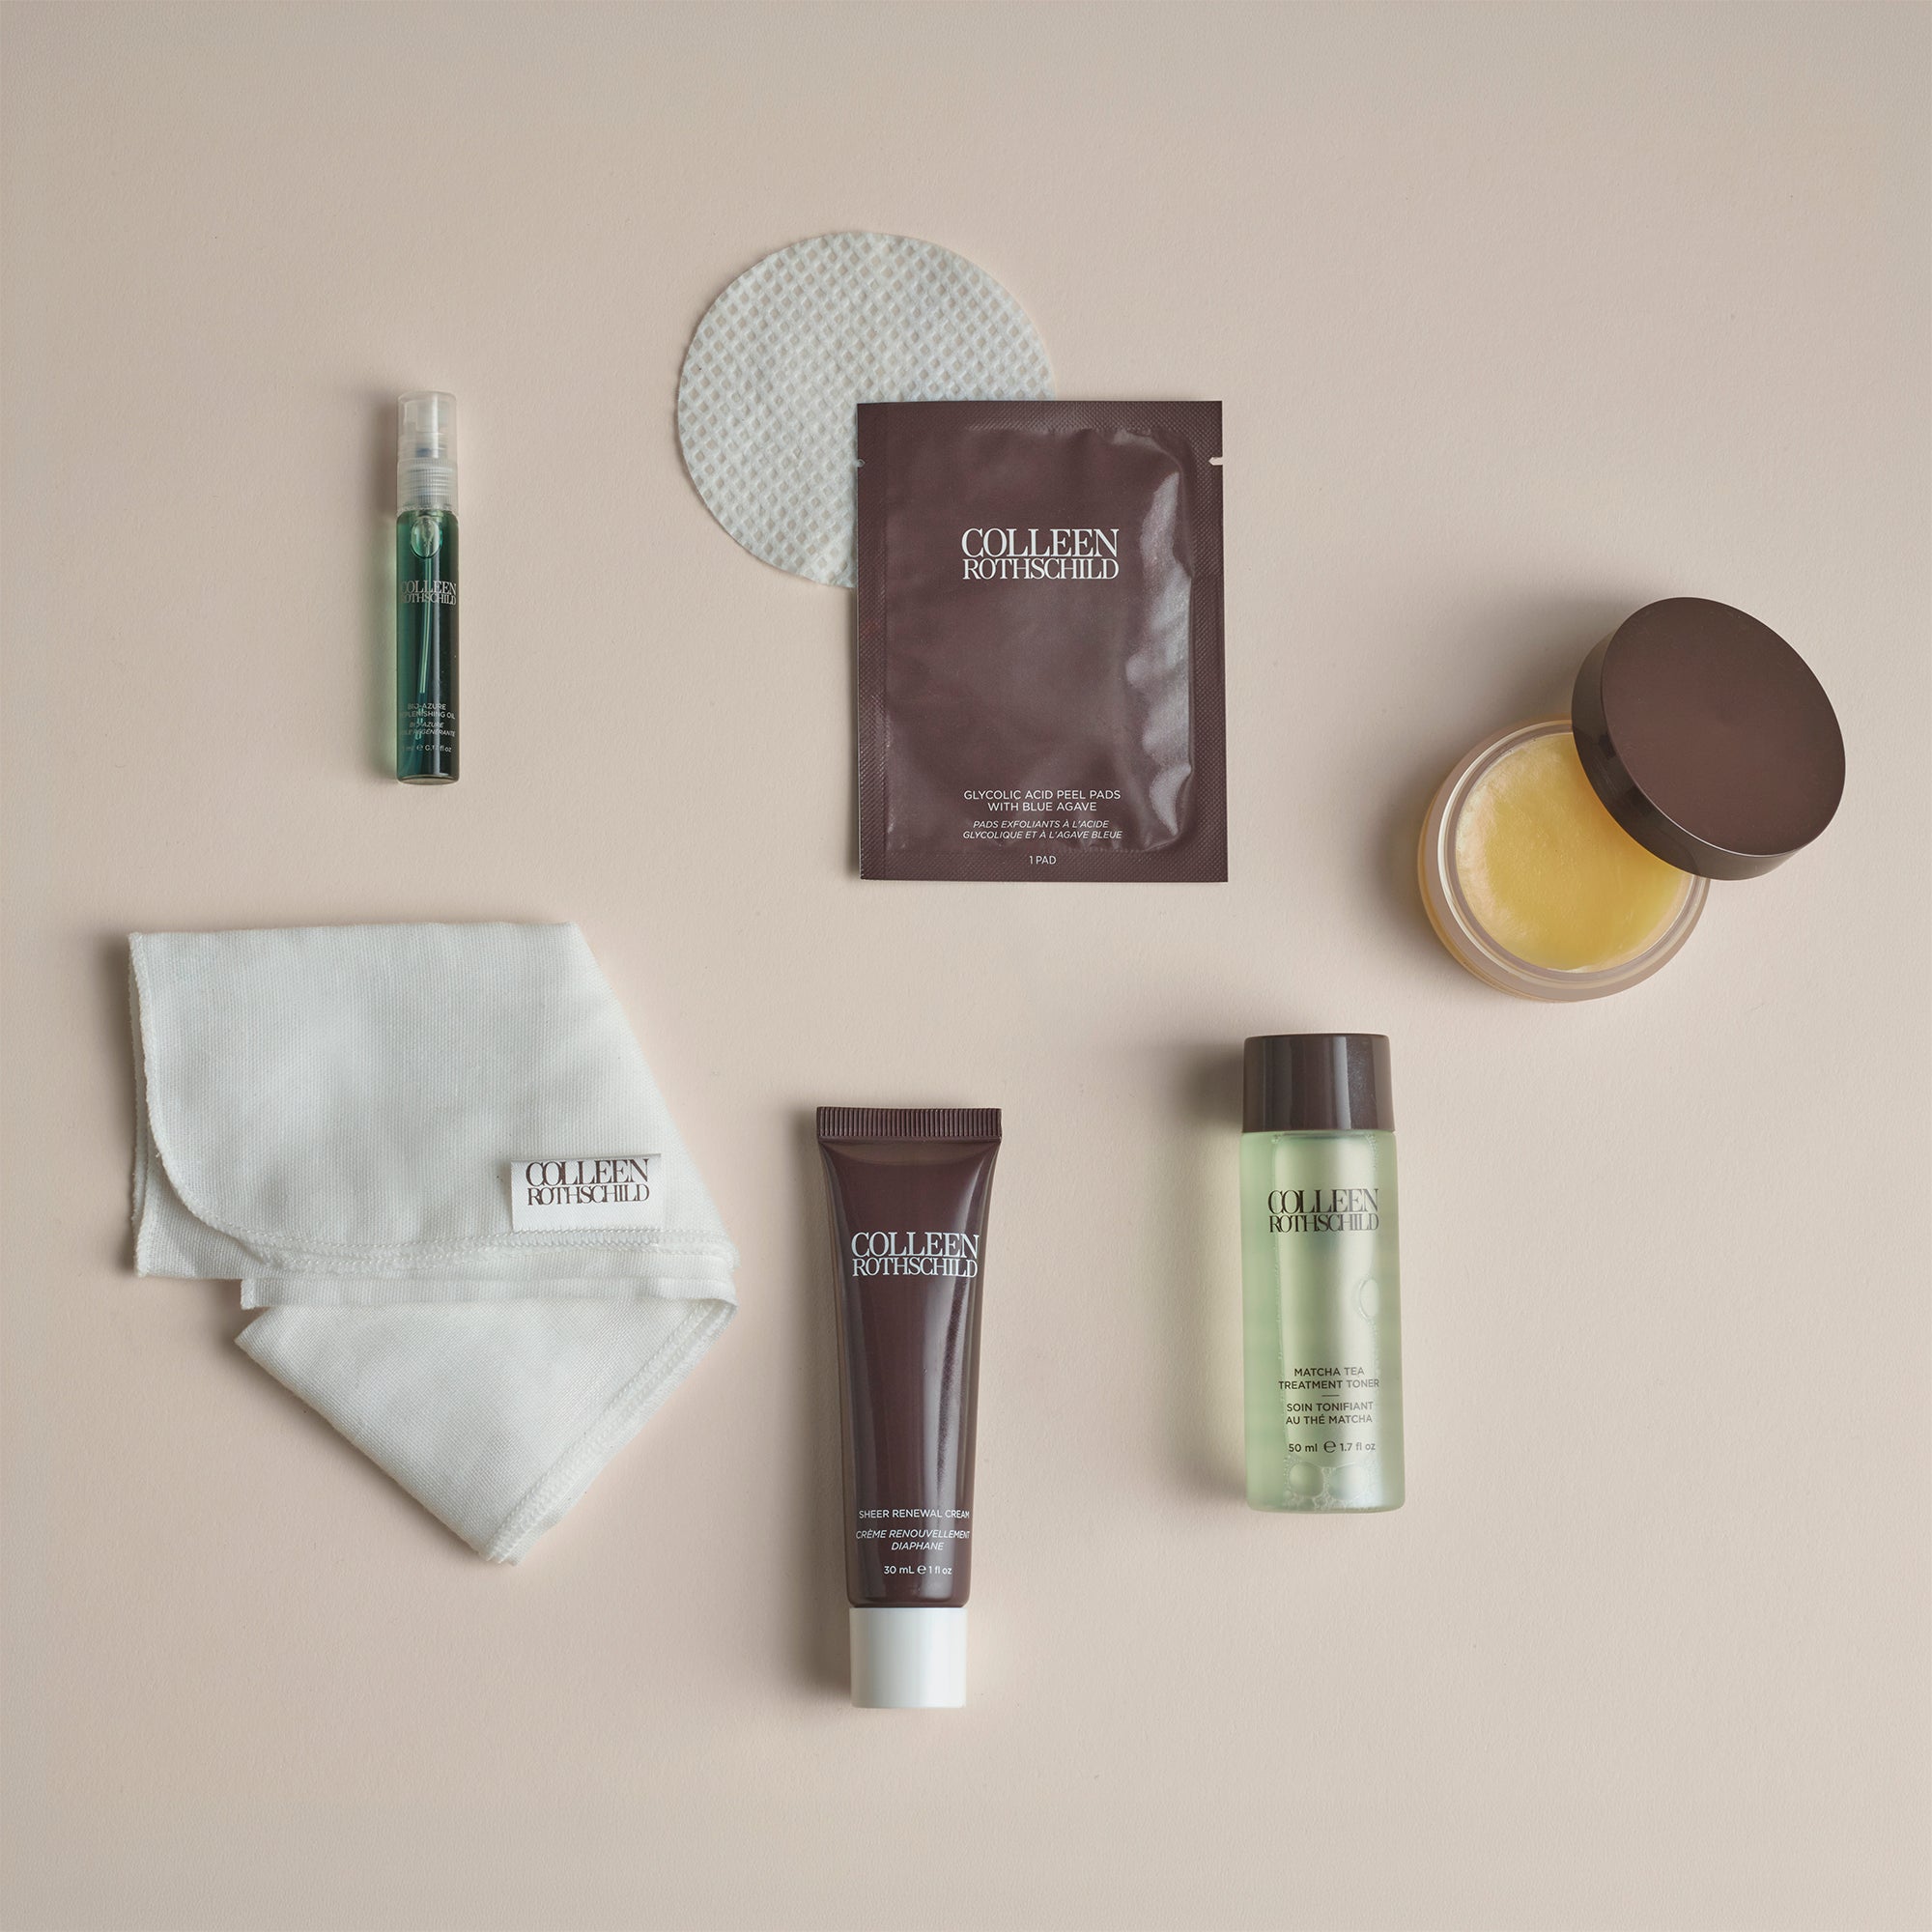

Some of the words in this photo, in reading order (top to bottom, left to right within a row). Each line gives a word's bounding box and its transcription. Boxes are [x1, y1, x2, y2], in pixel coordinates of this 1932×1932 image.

[961, 527, 1120, 558] COLLEEN
[962, 558, 1120, 580] ROTHSCHILD
[402, 580, 457, 595] COLLEEN
[963, 790, 1022, 800] GLYCOLIC
[1024, 790, 1053, 800] ACID
[1056, 790, 1086, 800] PEEL
[1090, 790, 1122, 800] PADS
[987, 802, 1019, 811] WITH
[1022, 802, 1053, 811] BLUE
[1056, 802, 1097, 811] AGAVE
[973, 820, 999, 829] PADS
[1001, 820, 1061, 829] EXFOLIANTS
[1063, 818, 1069, 828] À
[1072, 820, 1109, 829] L'ACIDE
[962, 831, 1023, 839] GLYCOLIQUE
[1038, 829, 1046, 838] À
[1049, 831, 1090, 839] L'AGAVE
[1030, 856, 1034, 865] 1
[1036, 856, 1057, 865] PAD
[526, 1158, 649, 1186] COLLEEN
[527, 1183, 650, 1206] ROTHSCHILD
[1267, 1188, 1379, 1214] COLLEEN
[1269, 1213, 1379, 1233] ROTHSCHILD
[851, 1231, 980, 1259] COLLEEN
[852, 1257, 979, 1278] ROTHSCHILD
[1294, 1368, 1341, 1377] MATCHA
[1278, 1380, 1343, 1389] TREATMENT
[1347, 1378, 1379, 1388] TONER
[1287, 1403, 1313, 1411] SOIN
[1316, 1402, 1374, 1411] TONIFIANT
[1286, 1416, 1300, 1425] AU
[1303, 1413, 1325, 1425] THÉ
[1328, 1415, 1373, 1424] MATCHA
[1289, 1443, 1301, 1453] 50
[1304, 1443, 1318, 1452] ml
[1340, 1443, 1352, 1452] 1.7
[1356, 1442, 1362, 1451] fl
[859, 1509, 890, 1519] SHEER
[892, 1509, 942, 1519] RENEWAL
[945, 1510, 970, 1519] CREAM
[855, 1529, 887, 1539] CRÈME
[889, 1529, 970, 1539] RENOUVELLEMENT
[891, 1542, 945, 1550] DIAPHANE
[884, 1566, 896, 1575] 30
